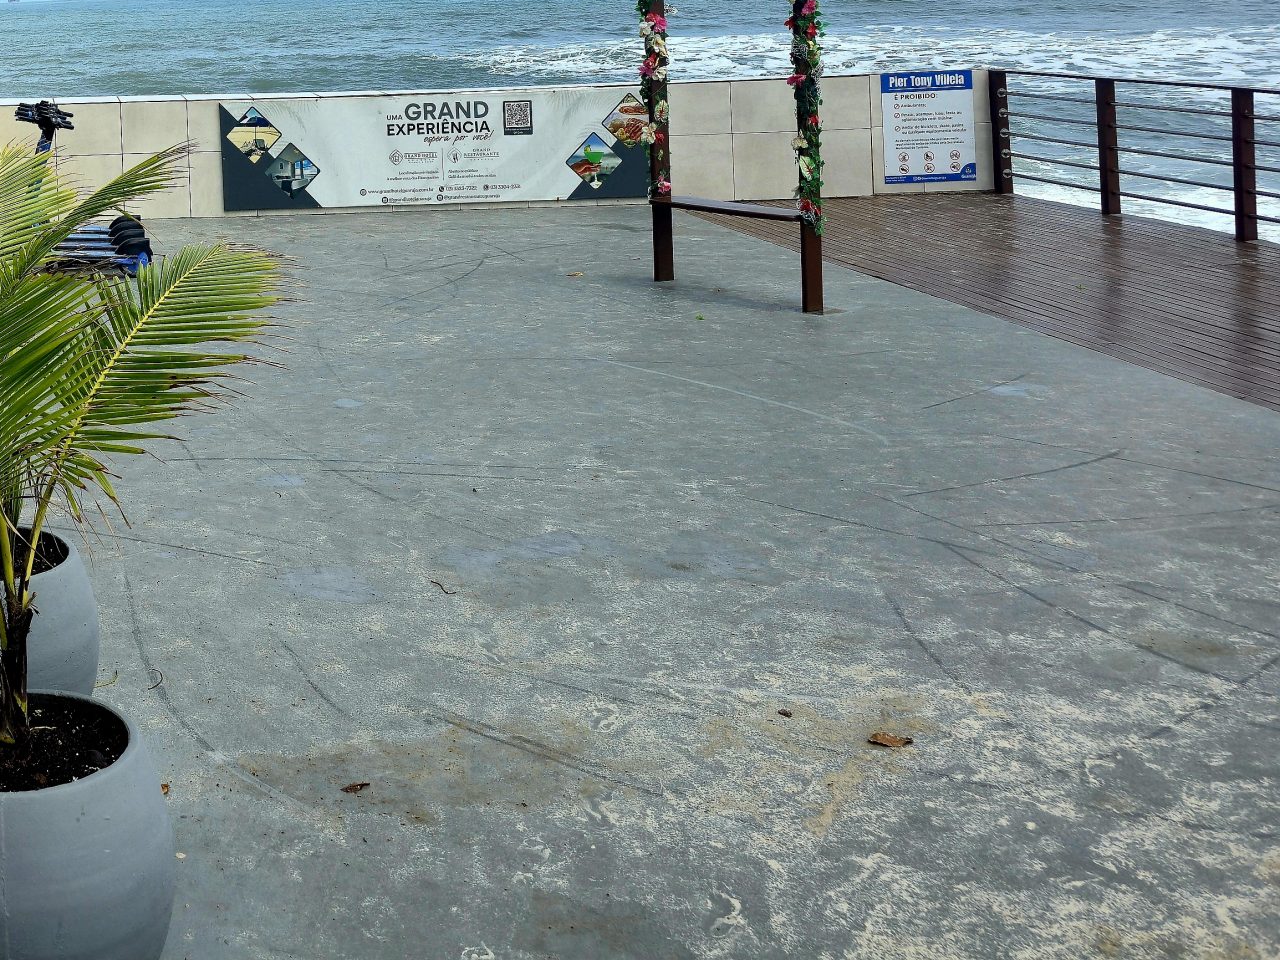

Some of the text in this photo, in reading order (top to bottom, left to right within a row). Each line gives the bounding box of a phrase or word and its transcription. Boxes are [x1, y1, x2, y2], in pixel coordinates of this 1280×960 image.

[889, 73, 965, 88] Pier Tony Villela
[900, 92, 938, 100] PROIBIDO:
[404, 100, 489, 121] GRAND
[386, 118, 491, 136] EXPERIÊNCIA
[423, 135, 451, 147] espera
[452, 135, 469, 146] por
